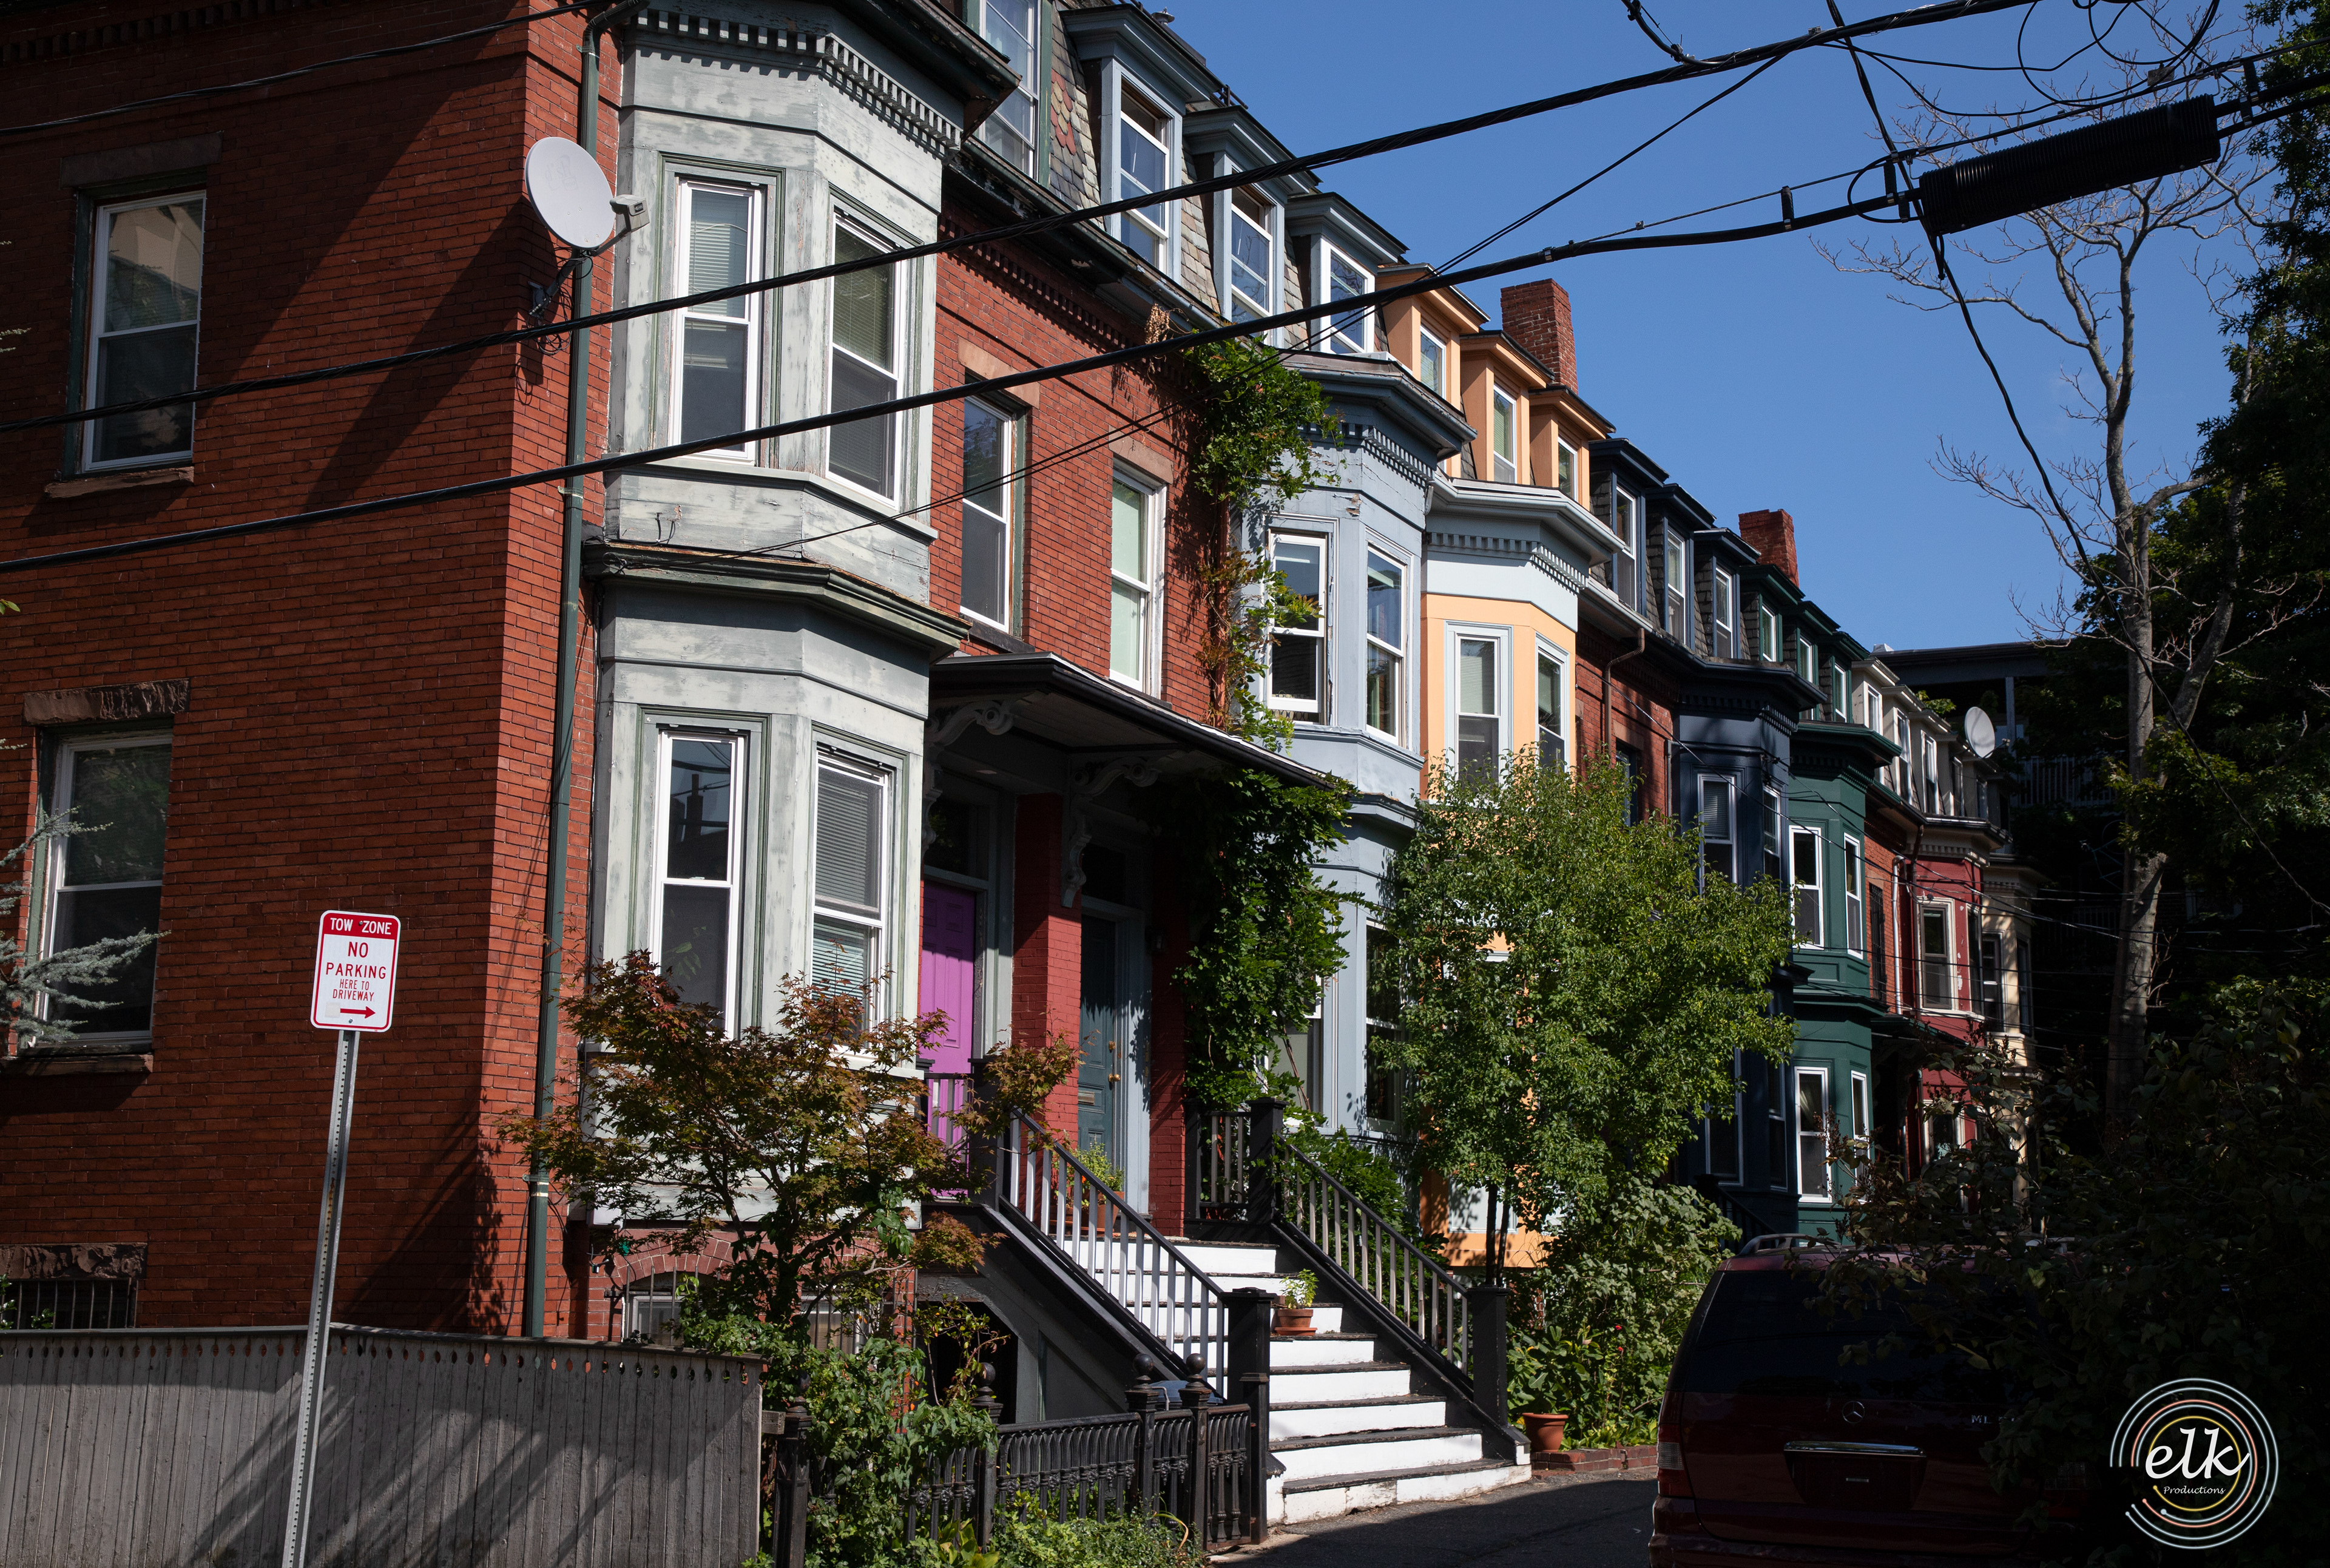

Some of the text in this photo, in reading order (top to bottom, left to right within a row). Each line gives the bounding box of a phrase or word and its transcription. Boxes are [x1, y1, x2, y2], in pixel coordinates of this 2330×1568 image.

[330, 917, 392, 934] TOW ZONE
[348, 941, 368, 958] NO
[326, 962, 387, 979] PARKING
[339, 979, 370, 990] HERE TO
[333, 989, 374, 1001] DRIVEWAY
